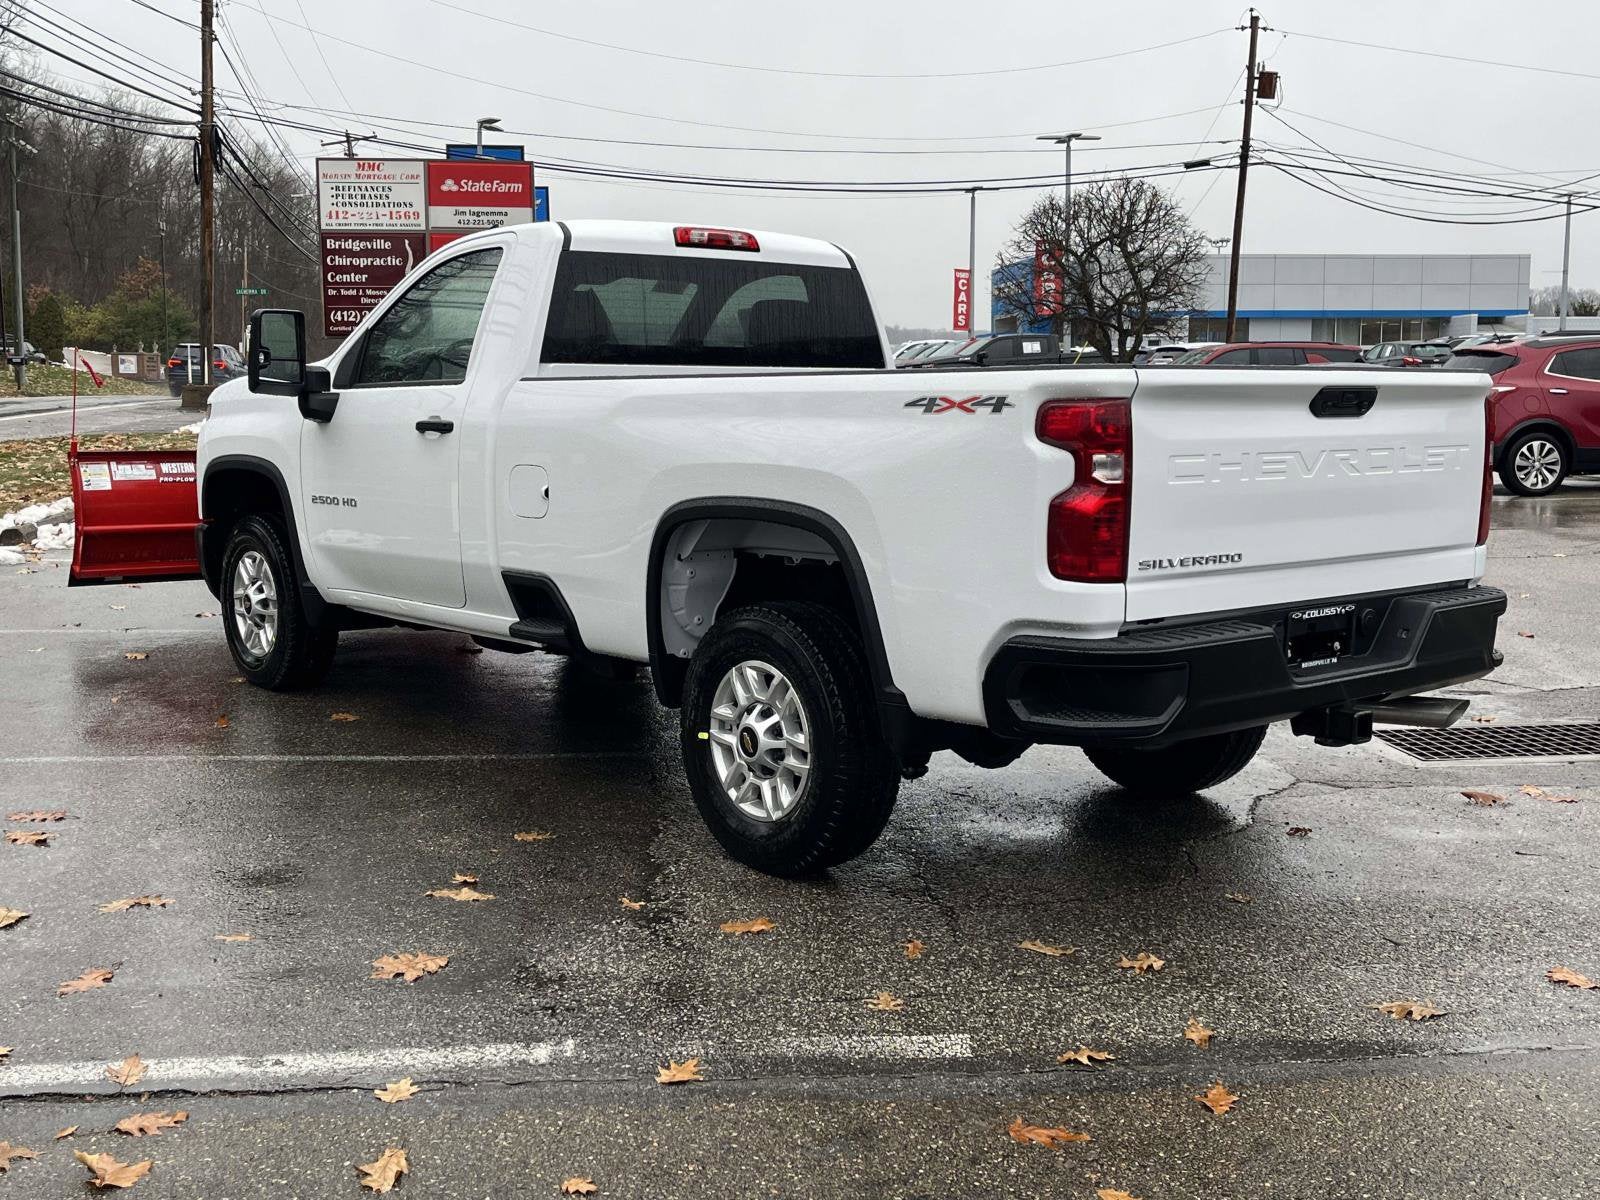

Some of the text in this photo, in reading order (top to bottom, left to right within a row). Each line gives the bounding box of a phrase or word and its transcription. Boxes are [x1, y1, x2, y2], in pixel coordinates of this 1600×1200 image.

[355, 162, 385, 172] MMC
[326, 239, 392, 251] Bridgeville
[326, 255, 403, 268] Chiropractic
[327, 272, 368, 283] Center
[957, 280, 967, 326] CARS
[330, 310, 360, 323] (412)
[160, 462, 196, 473] WESTERN
[1168, 444, 1470, 485] CHEVROLET
[312, 495, 357, 507] 2500 HD
[1138, 553, 1242, 571] SILVERADO
